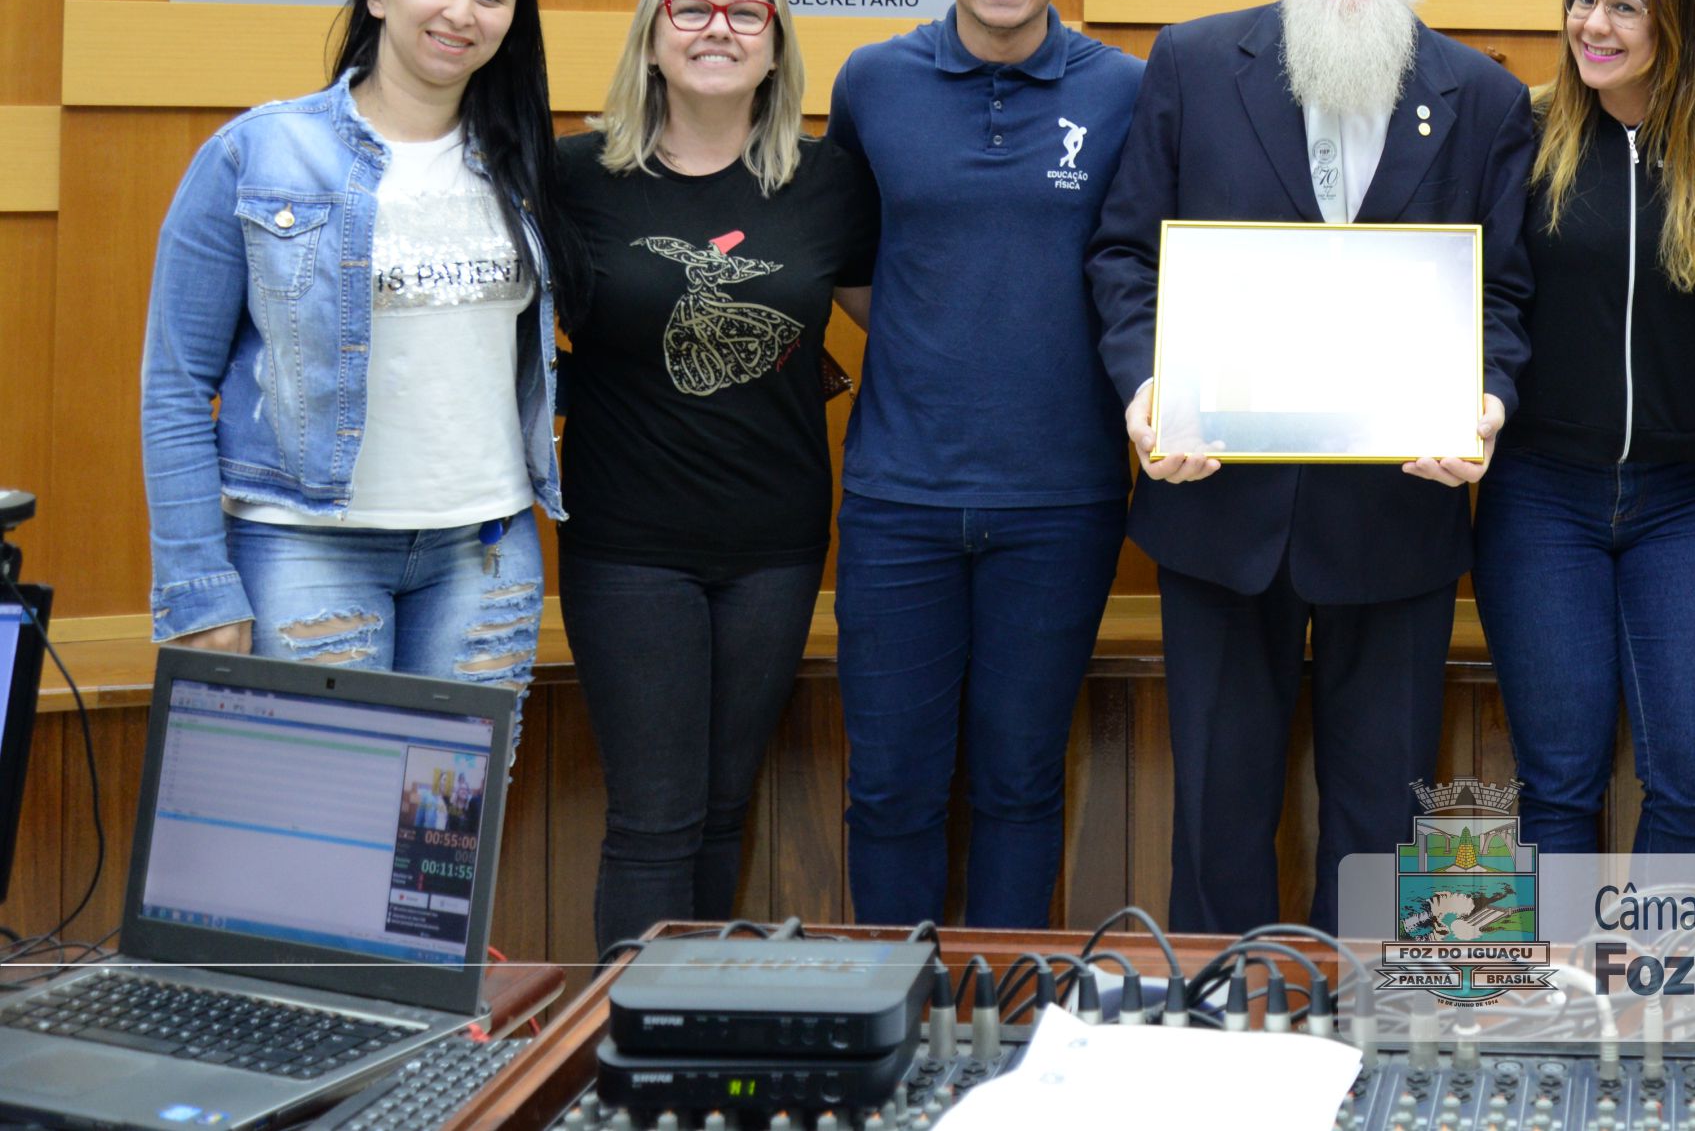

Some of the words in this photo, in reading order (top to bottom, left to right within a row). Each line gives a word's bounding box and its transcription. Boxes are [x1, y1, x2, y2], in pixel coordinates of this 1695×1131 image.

[1047, 170, 1089, 183] EDUCAÇÃO
[1055, 179, 1081, 190] FÍSICA
[425, 830, 477, 851] 00:55:00
[421, 859, 474, 880] 00:11:55
